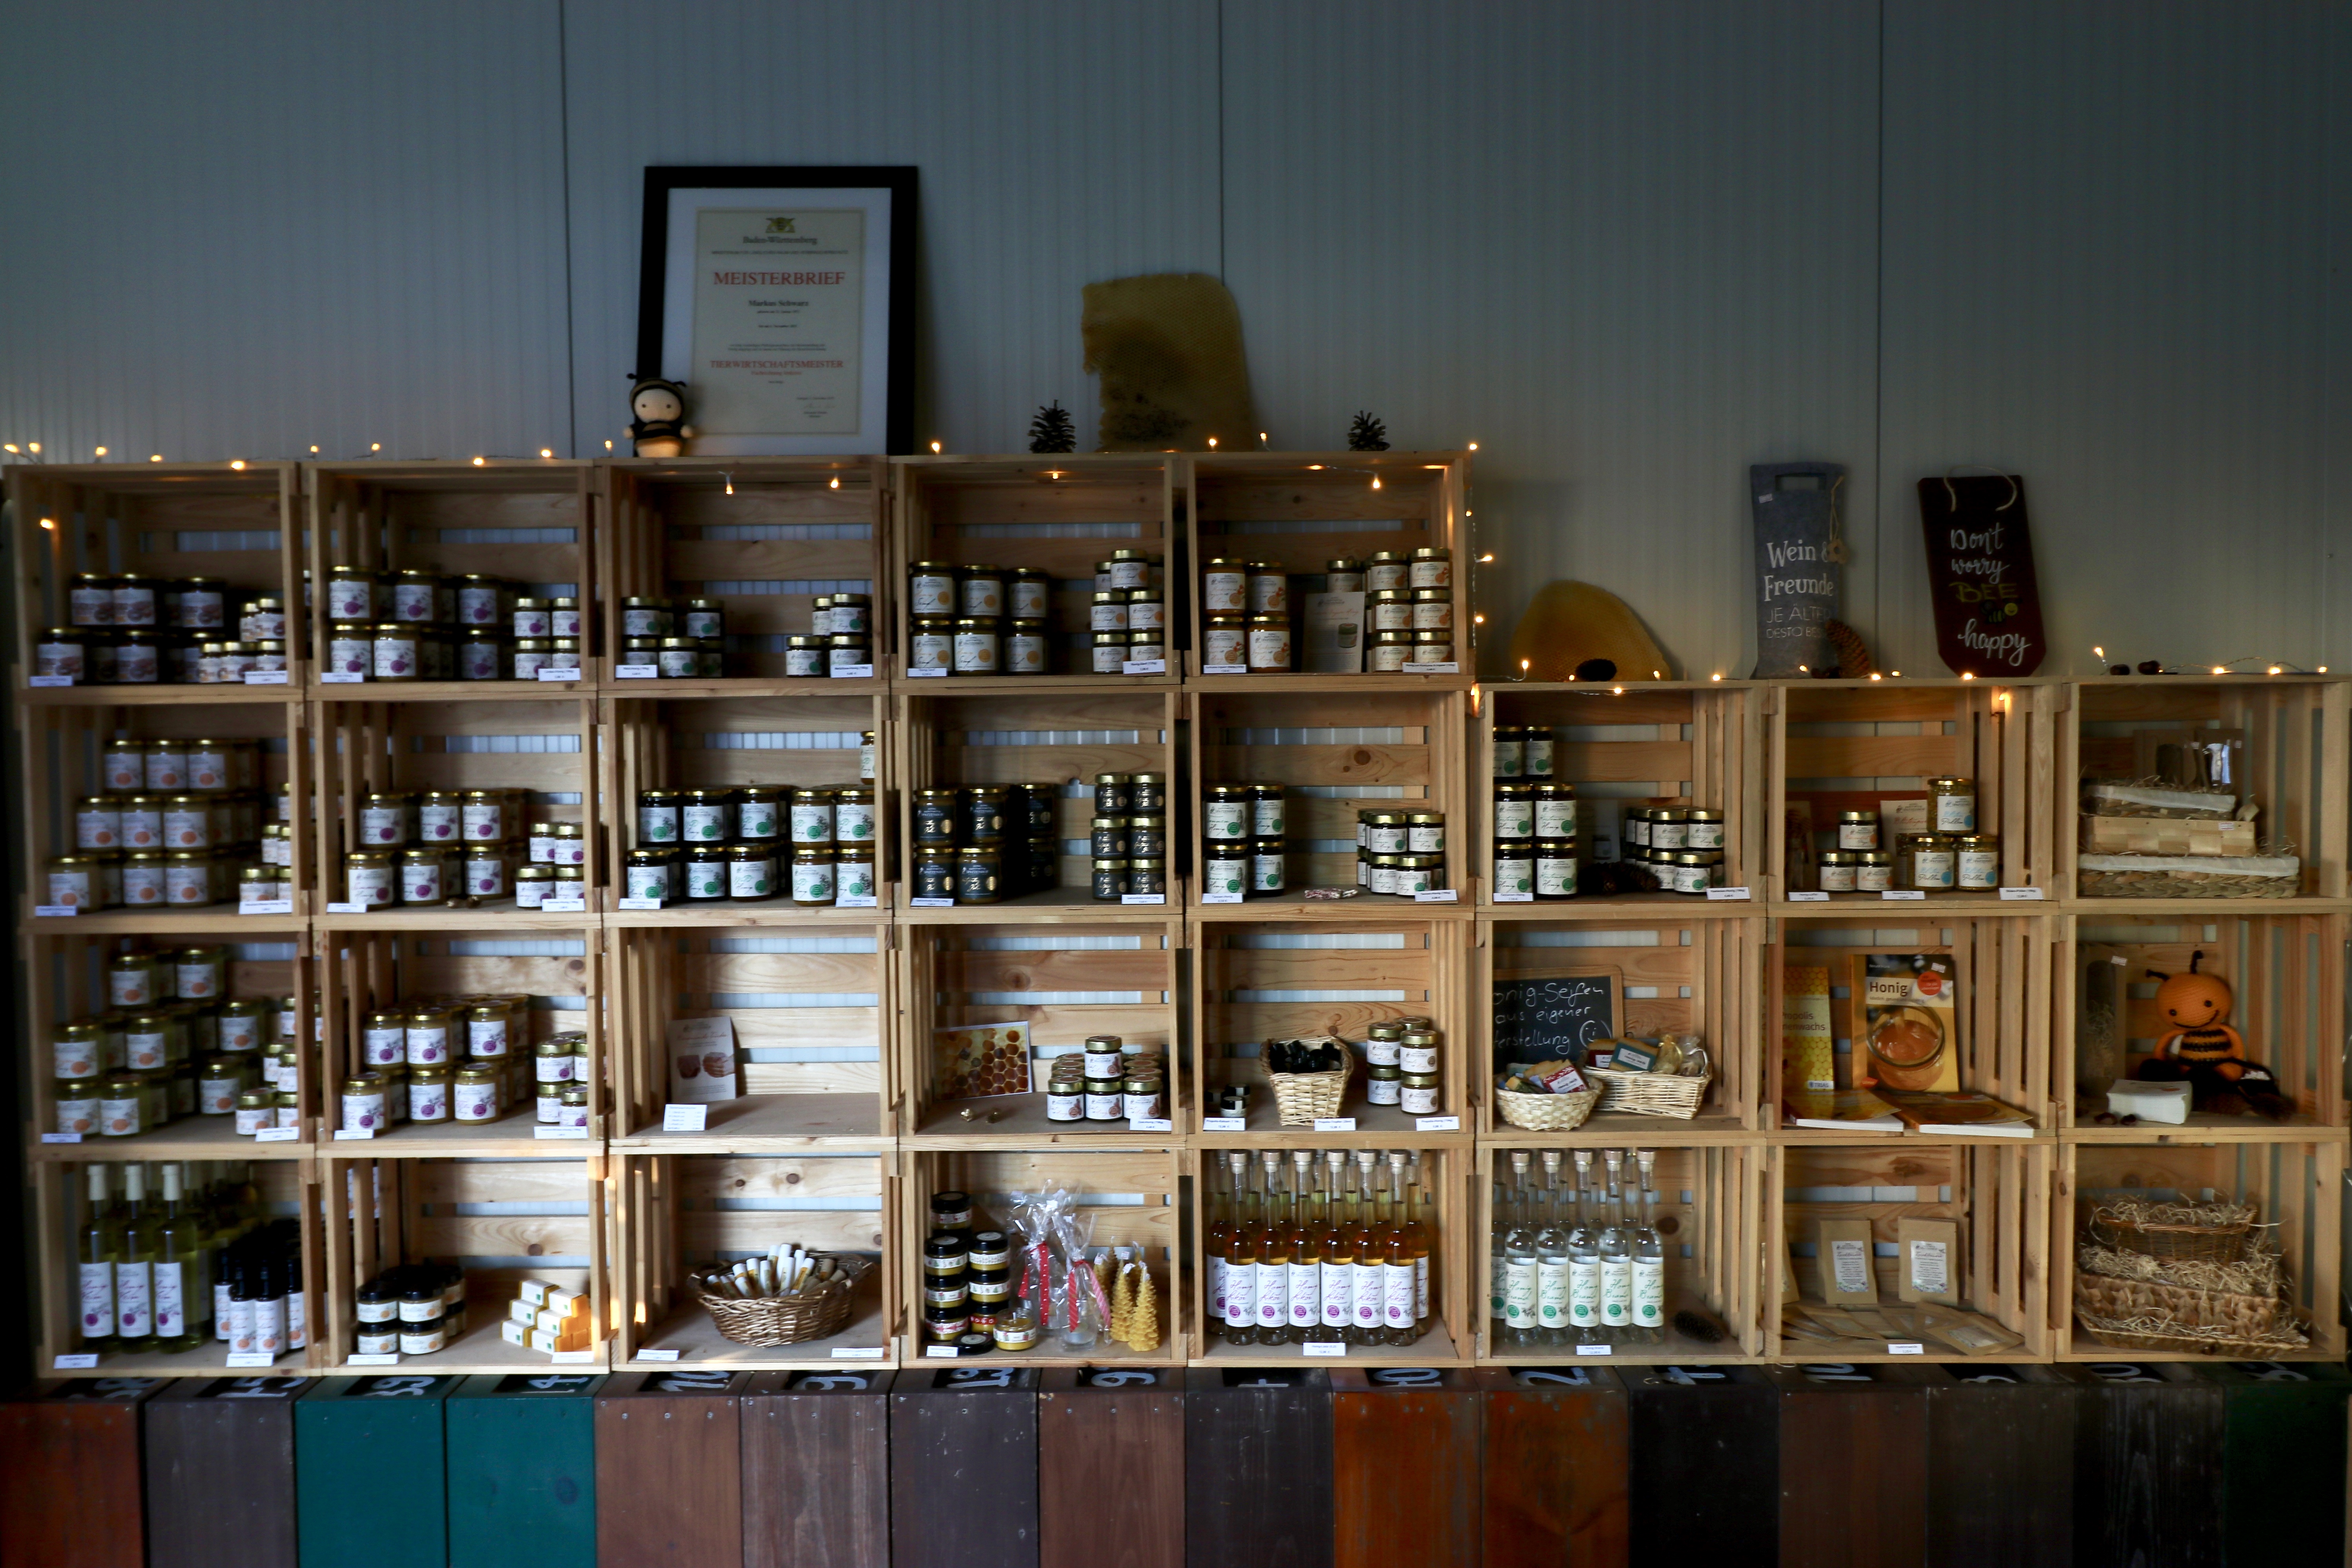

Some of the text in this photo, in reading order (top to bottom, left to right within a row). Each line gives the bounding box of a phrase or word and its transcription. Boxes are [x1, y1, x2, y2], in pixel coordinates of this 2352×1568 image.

[713, 272, 846, 285] MEISTERBRIEF
[710, 360, 844, 368] TIERWIRTSCHAFTSMEISTER
[1950, 522, 2005, 555] Don't
[1766, 539, 1816, 568] Wein
[1951, 558, 2011, 584] worry
[1764, 573, 1835, 601] Freunde
[1948, 581, 2019, 603] BEE
[1766, 608, 1783, 623] JE
[1766, 627, 1802, 639] DESTO
[1957, 618, 2033, 667] happy
[1493, 982, 1604, 1007] onig-Seifen
[1869, 981, 1907, 997] Honig
[1495, 1006, 1591, 1024] aus eigener
